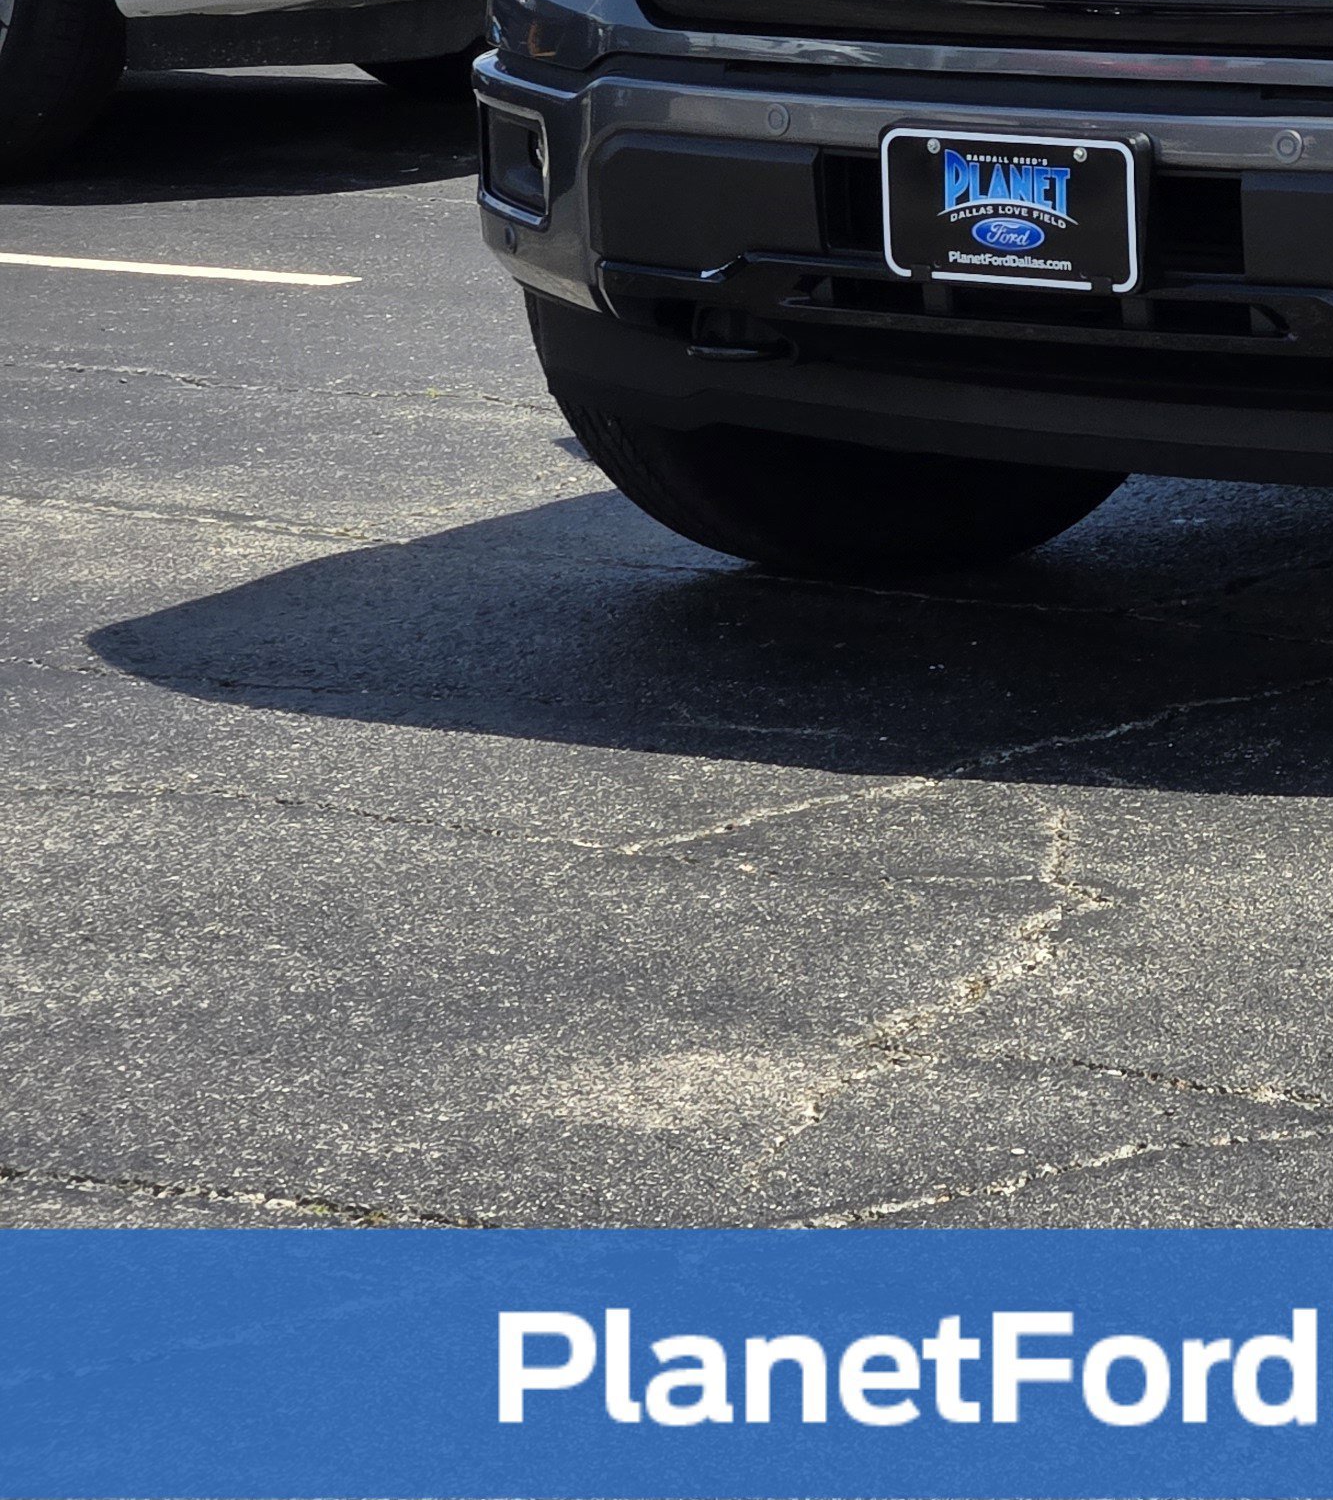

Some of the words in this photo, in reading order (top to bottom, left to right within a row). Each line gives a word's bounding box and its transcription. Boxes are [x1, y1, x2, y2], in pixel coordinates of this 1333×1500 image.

[944, 149, 1071, 216] PLANET
[950, 206, 994, 222] DALLAS
[998, 205, 1028, 217] LOVE
[1032, 210, 1067, 229] FIELD
[986, 221, 1031, 247] Ford
[948, 250, 1072, 271] PlanetFordDallas.com
